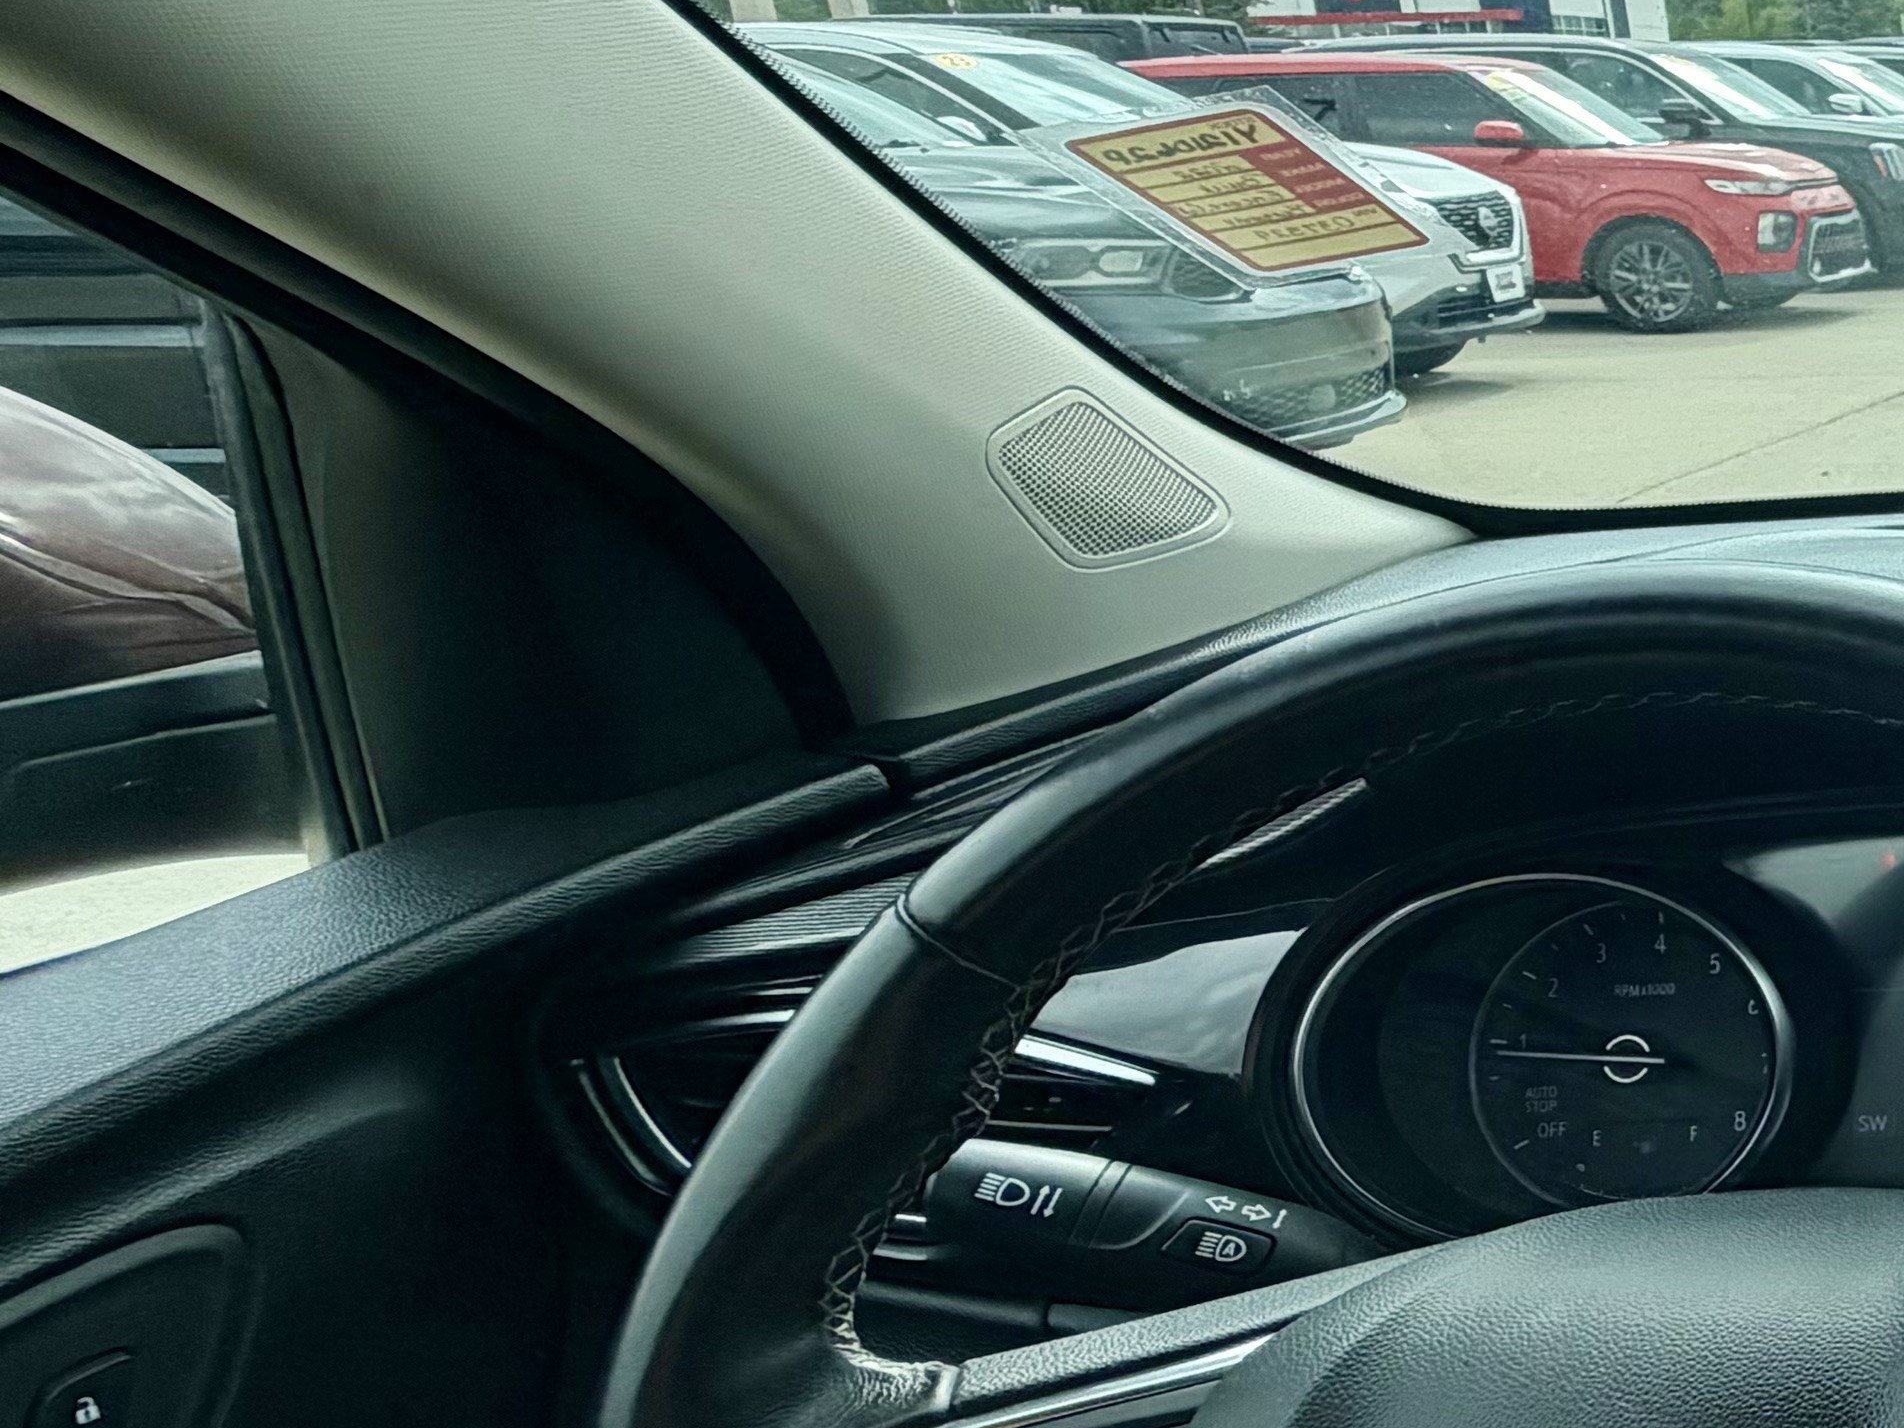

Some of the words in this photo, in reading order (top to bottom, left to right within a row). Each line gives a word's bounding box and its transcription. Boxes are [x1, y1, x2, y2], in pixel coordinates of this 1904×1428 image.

[1655, 934, 1666, 954] 4
[1597, 943, 1607, 963] 3
[1710, 953, 1721, 974] 5
[1548, 978, 1558, 998] 2
[1519, 1033, 1527, 1048] 1
[1525, 1086, 1557, 1099] AUTO
[1525, 1100, 1557, 1113] STOP
[1734, 1110, 1746, 1131] 8
[1857, 1114, 1888, 1132] SW
[1537, 1122, 1567, 1138] OFF
[1592, 1130, 1601, 1147] E
[1690, 1125, 1698, 1142] F
